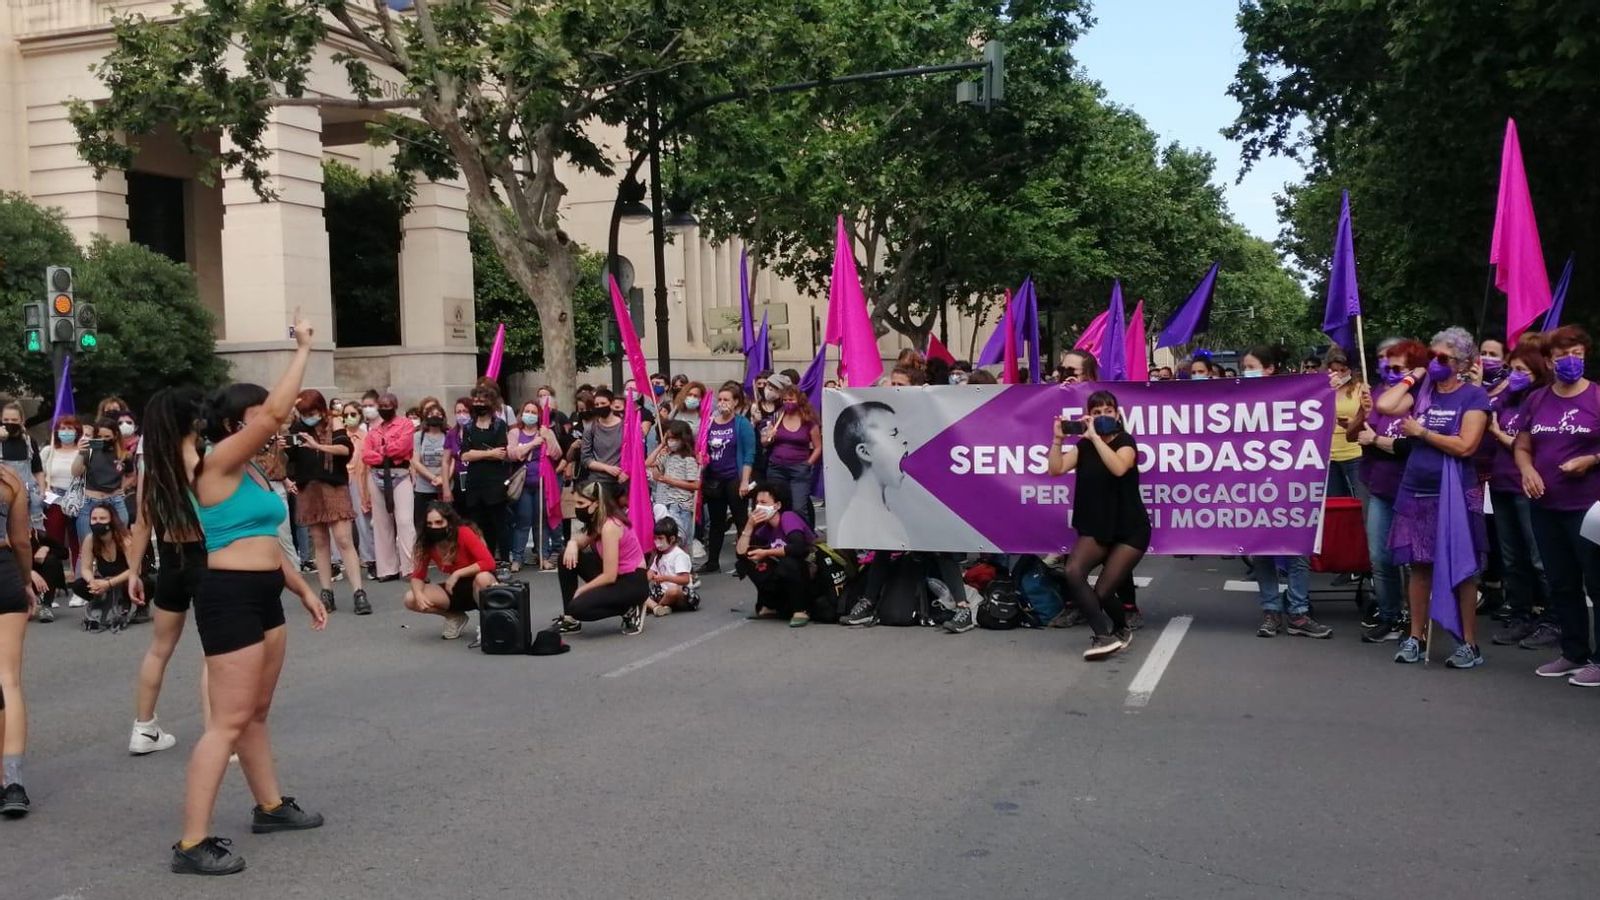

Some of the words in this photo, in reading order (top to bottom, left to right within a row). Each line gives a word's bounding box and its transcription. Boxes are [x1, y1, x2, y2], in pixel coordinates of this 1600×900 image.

[950, 444, 1076, 475] SENS
[1136, 439, 1325, 474] ORDASSA
[1020, 485, 1070, 505] PER
[1138, 476, 1279, 504] EROGACIÓ
[1288, 481, 1324, 503] DE
[1170, 507, 1320, 529] MORDASSA
